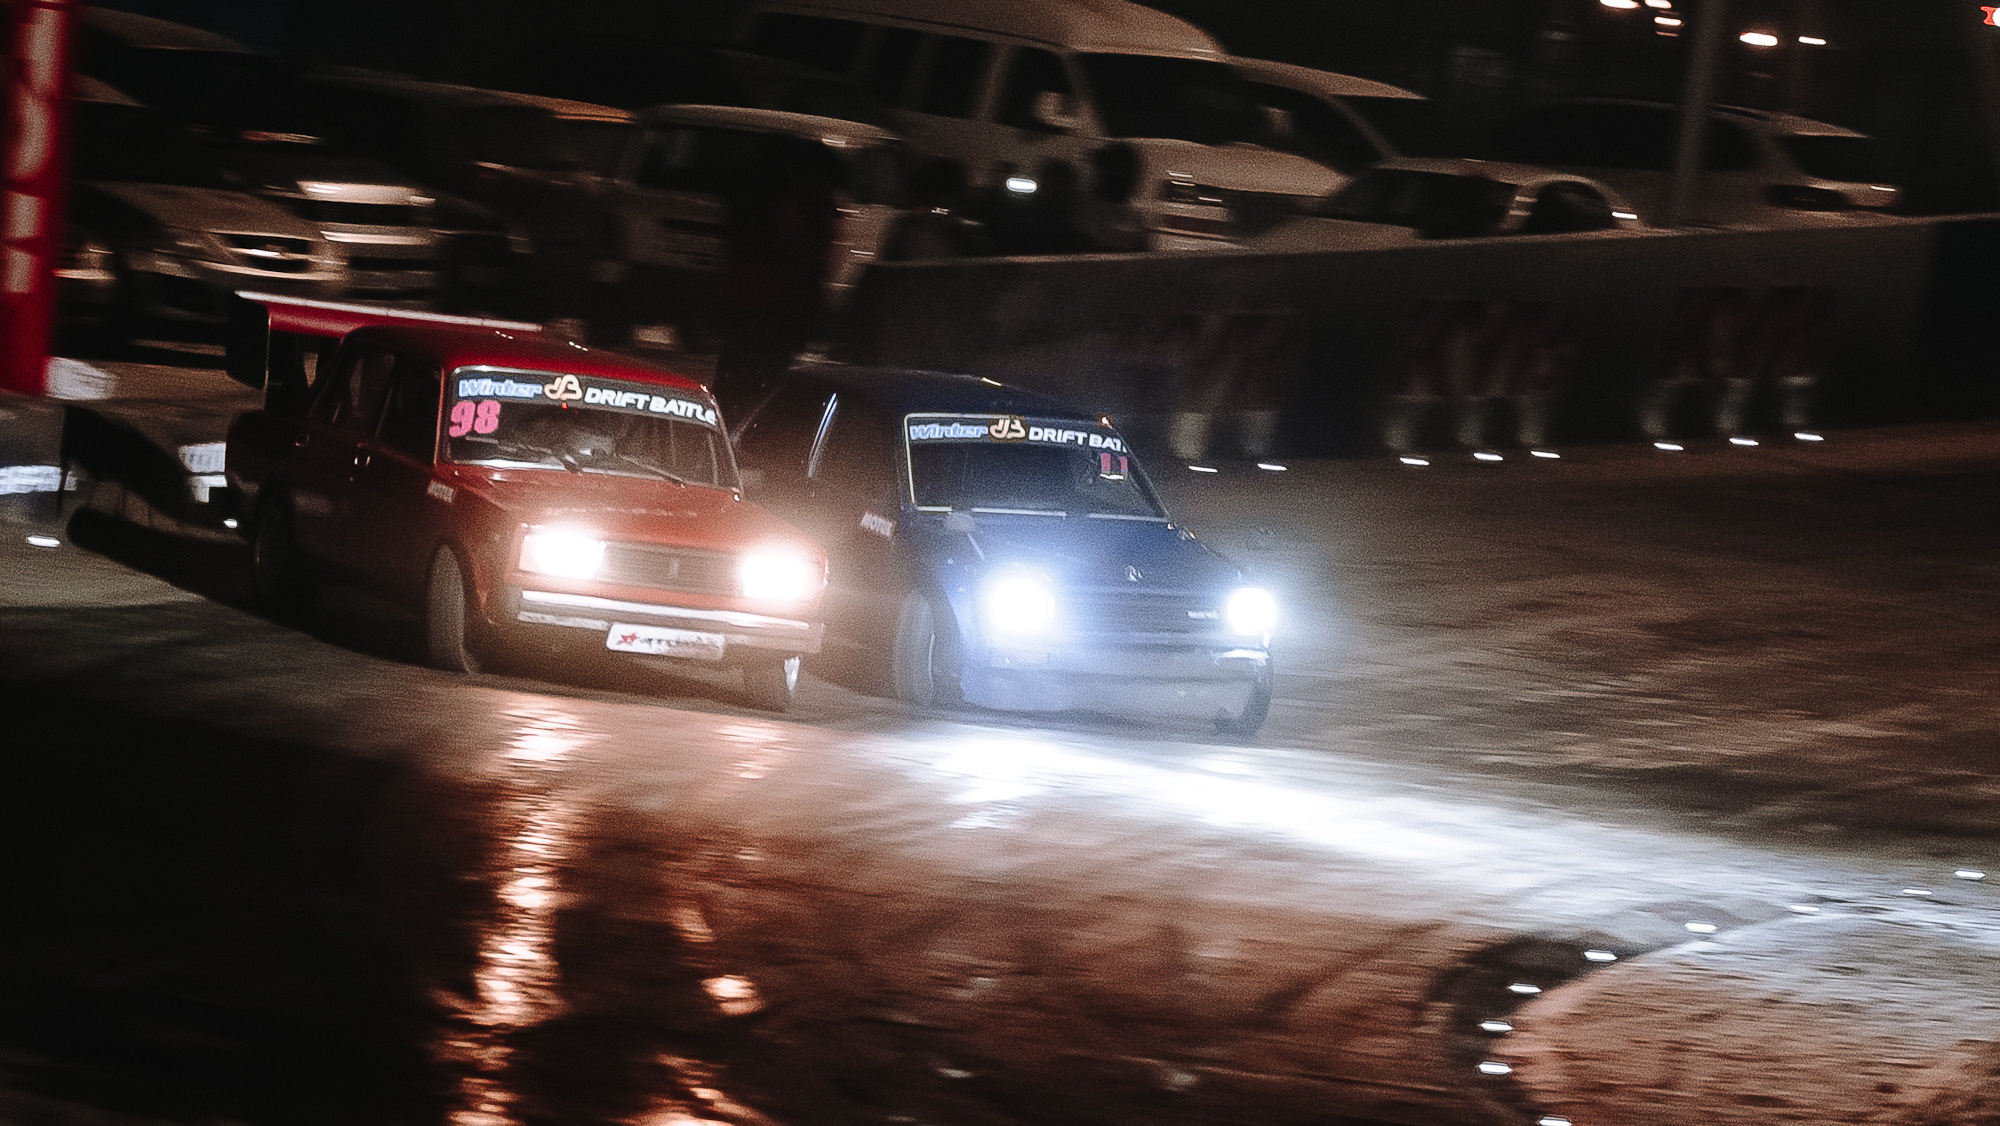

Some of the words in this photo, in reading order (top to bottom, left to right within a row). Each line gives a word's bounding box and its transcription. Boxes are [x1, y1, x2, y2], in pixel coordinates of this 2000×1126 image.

[449, 400, 501, 437] 98
[458, 378, 543, 398] Winter
[584, 387, 650, 411] DRIFT
[649, 396, 717, 426] BATTLE
[909, 424, 988, 440] Winter
[1028, 427, 1087, 446] DRIFT
